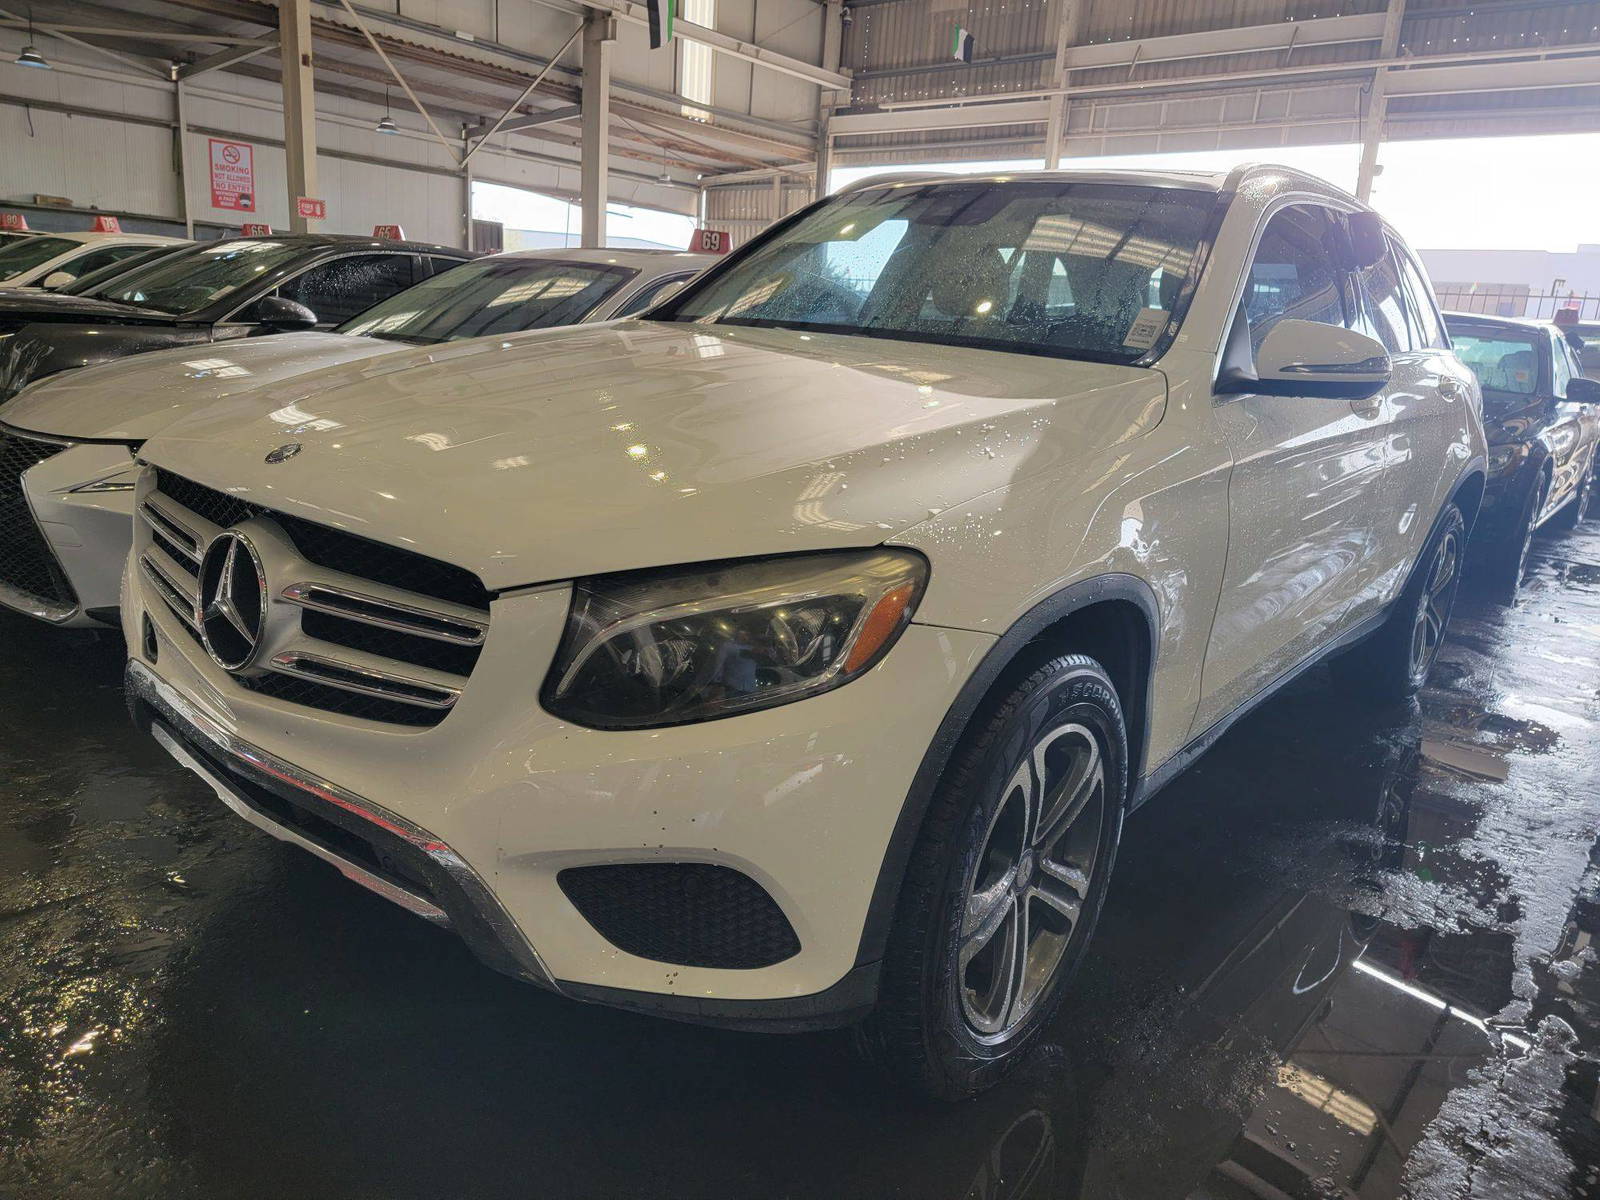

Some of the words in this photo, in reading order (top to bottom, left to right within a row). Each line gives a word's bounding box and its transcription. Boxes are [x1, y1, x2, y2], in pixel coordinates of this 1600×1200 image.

[215, 163, 249, 175] SMOKING
[215, 181, 226, 190] NO
[702, 231, 720, 250] 69
